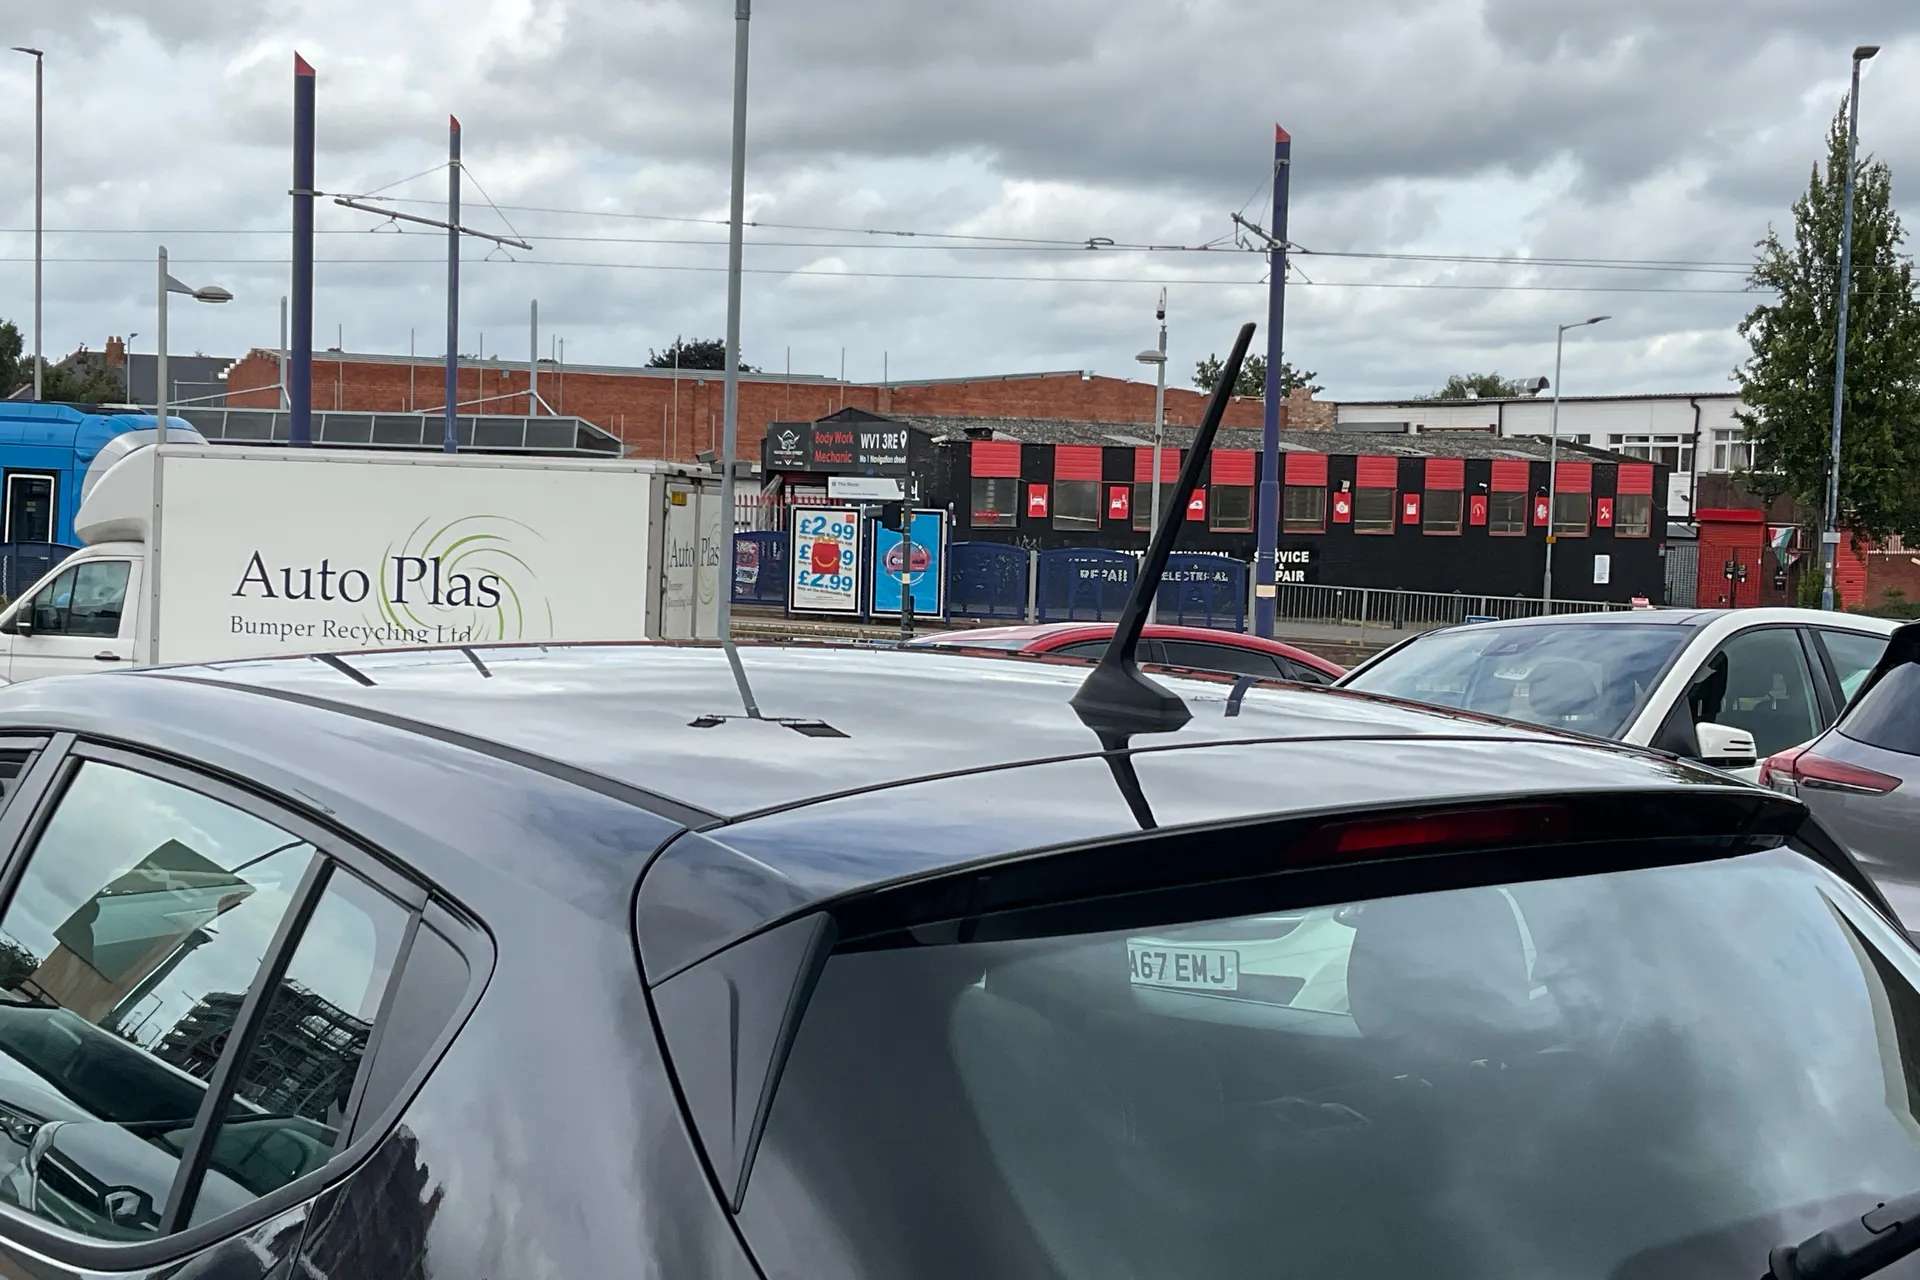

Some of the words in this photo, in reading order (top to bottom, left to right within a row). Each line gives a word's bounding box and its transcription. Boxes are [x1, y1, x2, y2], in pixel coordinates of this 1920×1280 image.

[834, 431, 854, 445] Work
[860, 433, 880, 449] WV1
[882, 433, 898, 449] 3RE
[815, 449, 853, 463] Mechanic
[800, 515, 854, 540] £2.99
[670, 538, 694, 567] Auto
[700, 538, 719, 567] Plas
[1254, 551, 1309, 563] SRVICE
[231, 549, 370, 604] Auto
[390, 556, 501, 608] Plas
[798, 570, 853, 592] £2.99
[1274, 570, 1305, 582] PAIR
[230, 615, 316, 643] Bumper
[322, 619, 428, 646] Recycling
[436, 624, 471, 643] Ltd
[1175, 954, 1225, 983] EMJ
